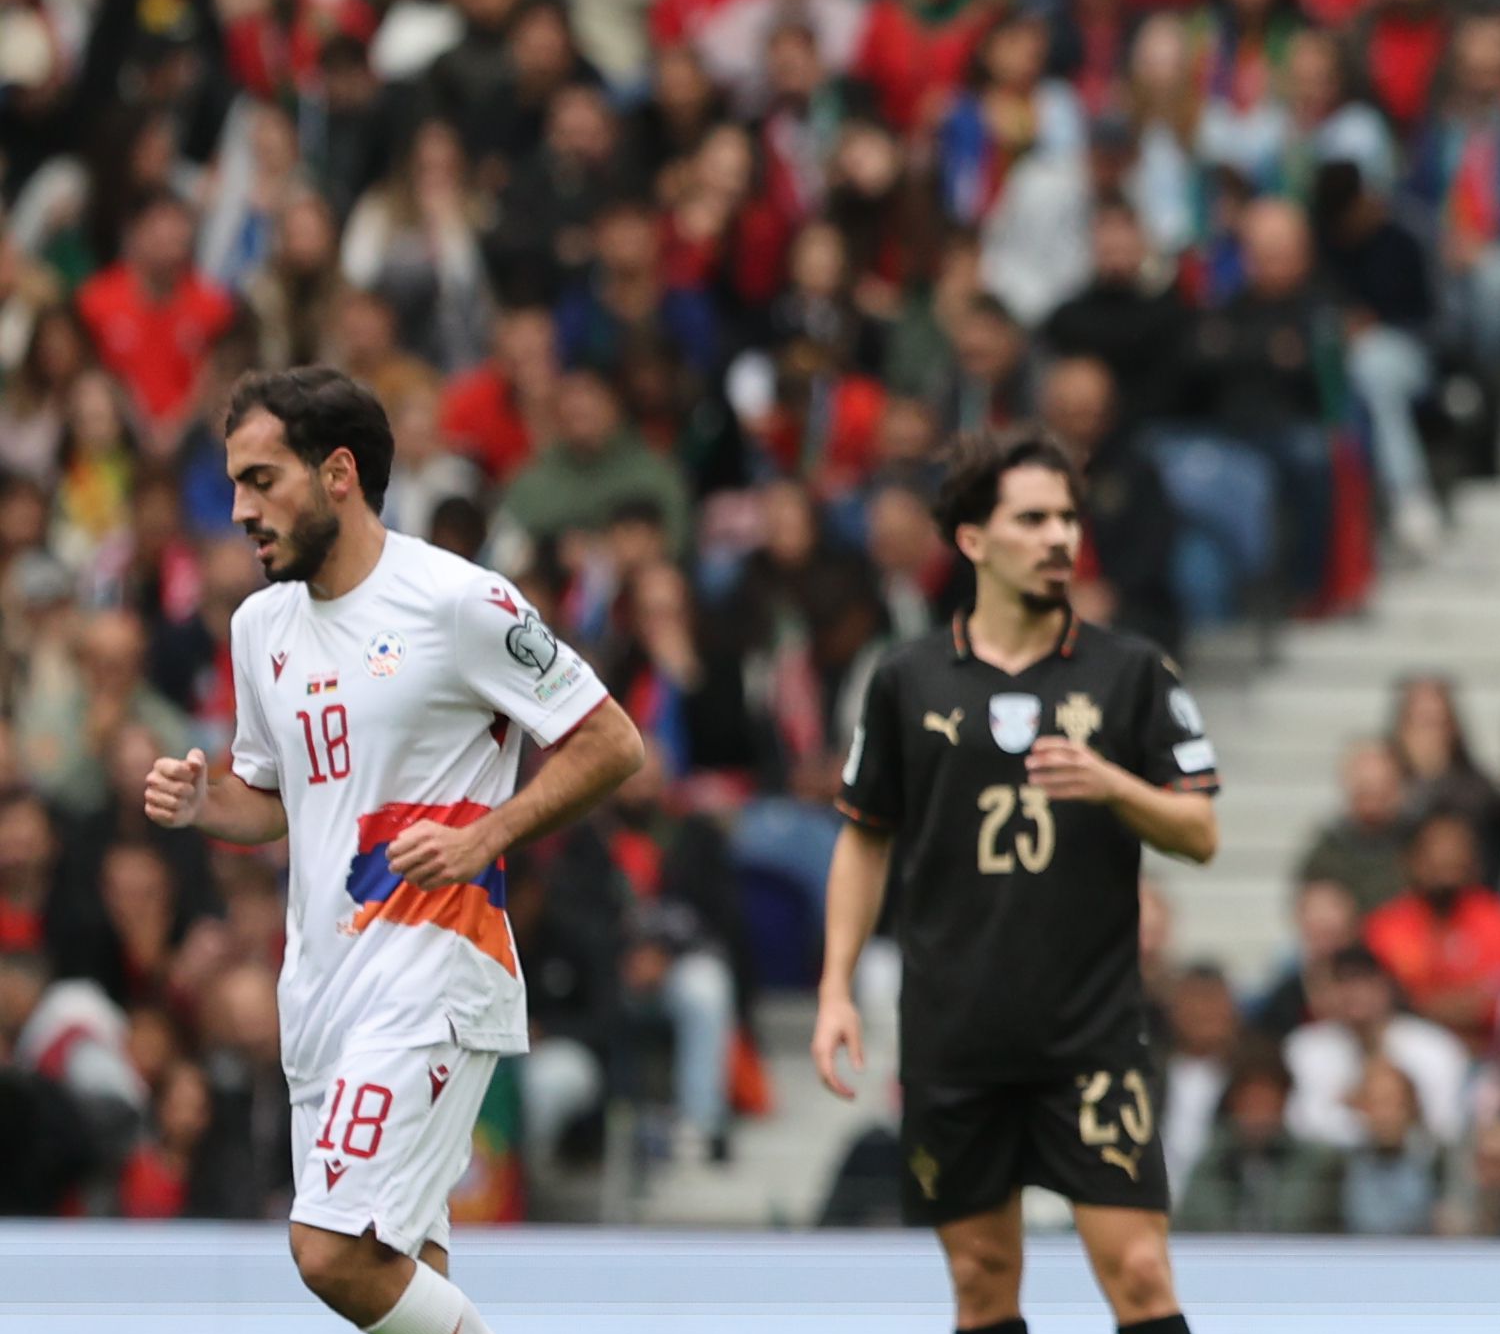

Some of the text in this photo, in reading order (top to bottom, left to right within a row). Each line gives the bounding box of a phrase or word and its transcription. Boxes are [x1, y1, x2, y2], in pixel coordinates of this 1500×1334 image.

[296, 704, 350, 785] 18
[977, 783, 1055, 874] 23
[316, 1078, 393, 1159] 18
